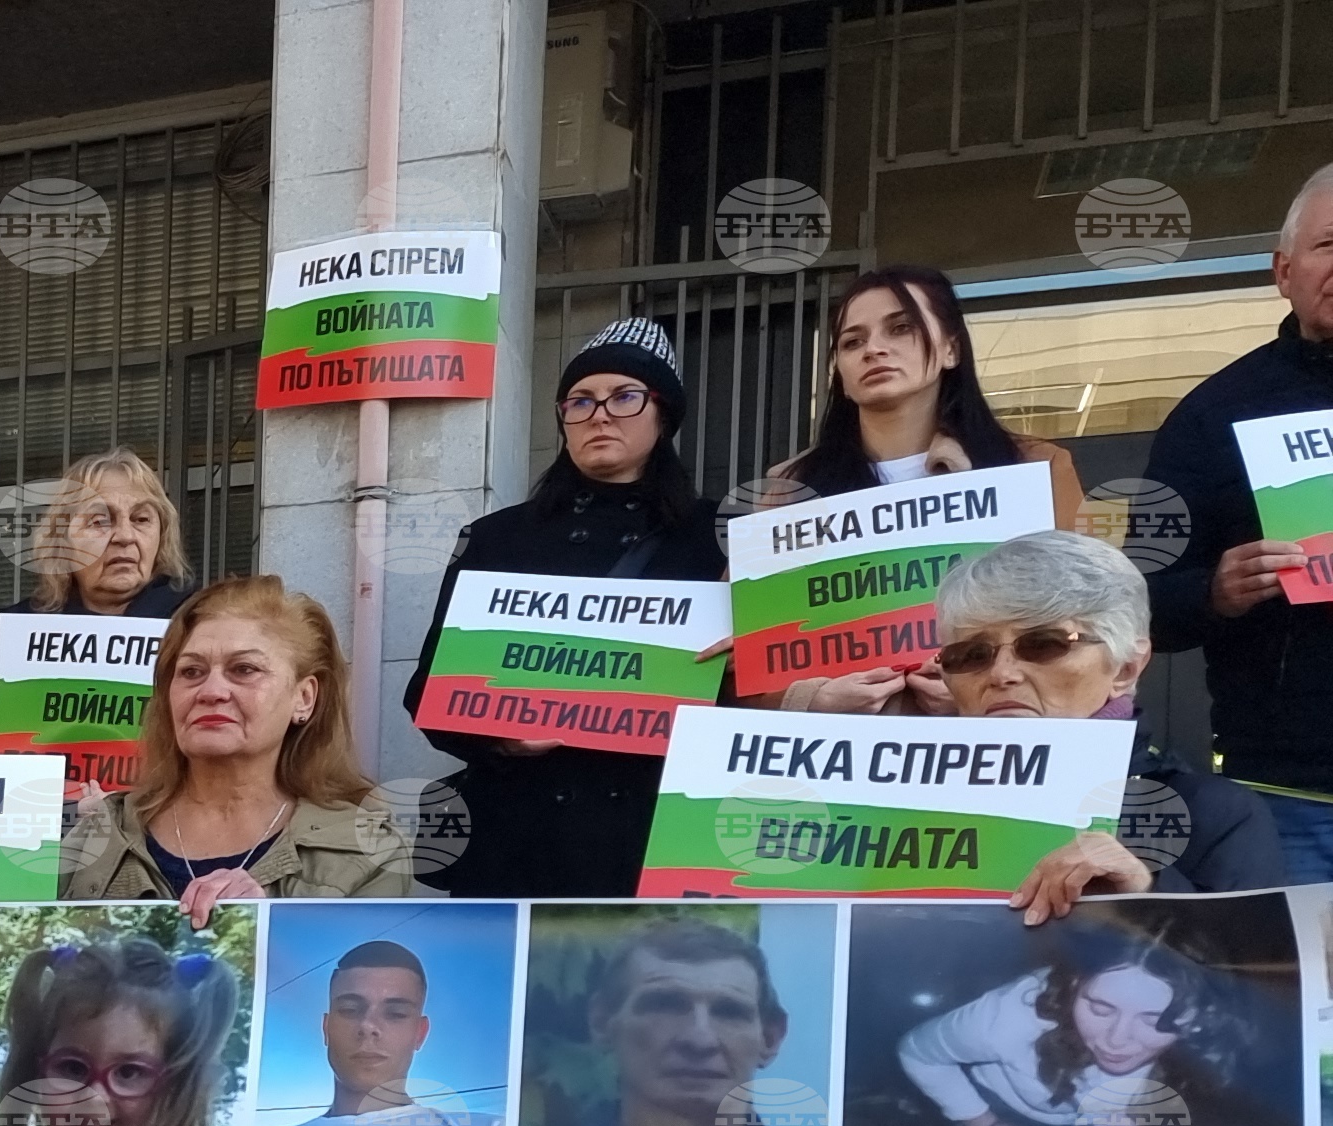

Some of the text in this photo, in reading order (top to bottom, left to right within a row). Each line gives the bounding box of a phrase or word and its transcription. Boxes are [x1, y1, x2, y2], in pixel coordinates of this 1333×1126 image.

[299, 247, 465, 287] НЕКА СПРЕМ
[316, 299, 434, 336] ВОЙНАТА
[279, 354, 465, 392] ПО ПЪТИЩАТА
[772, 486, 998, 554] НЕКА СПРЕМ
[488, 587, 692, 625] НЕКА СПРЕМ
[26, 631, 97, 663] НЕКА
[501, 641, 643, 680] ВОЙНАТА
[766, 638, 811, 674] ПО
[446, 690, 671, 739] ПО ПЪТИЩАТА
[726, 732, 1051, 786] НЕКА СПРЕМ
[755, 815, 978, 870] ВОЙНАТА
